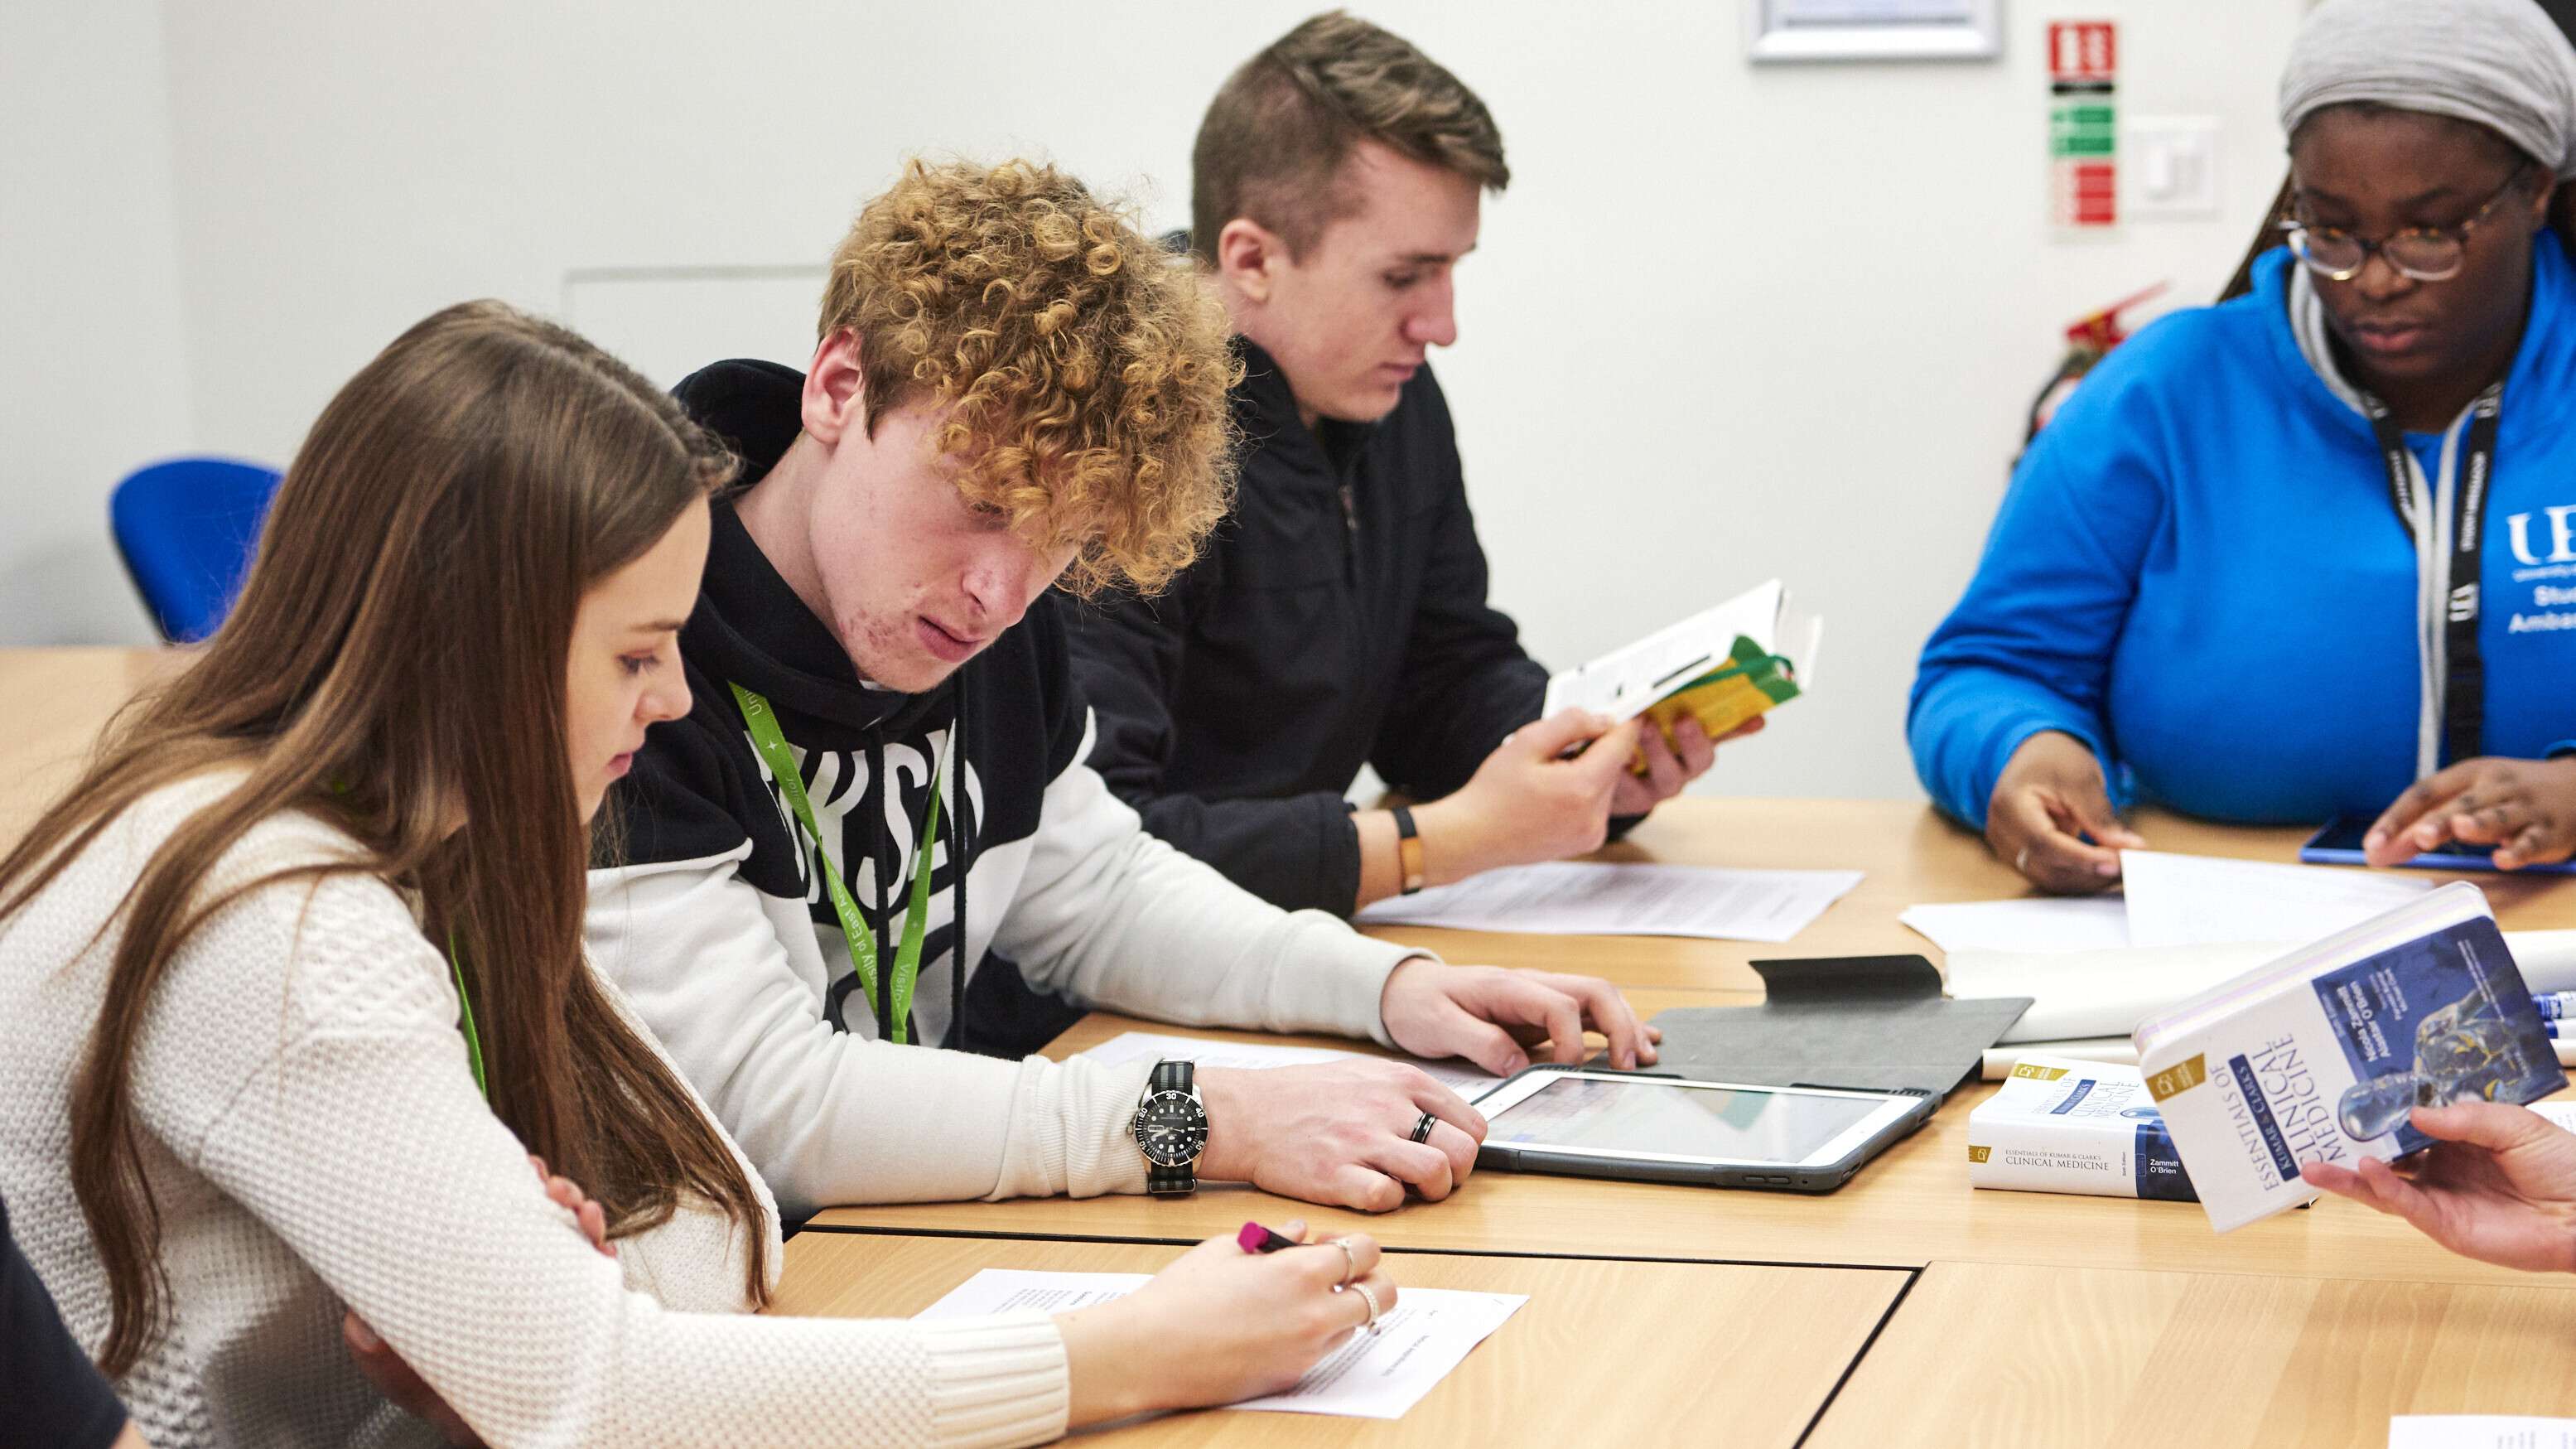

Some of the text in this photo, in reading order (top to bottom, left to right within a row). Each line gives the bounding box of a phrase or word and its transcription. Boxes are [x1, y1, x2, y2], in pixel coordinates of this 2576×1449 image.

[844, 908, 863, 939] East
[855, 939, 867, 952] of
[2252, 1041, 2324, 1166] CLINICAL
[2272, 1033, 2347, 1162] MEDICINE
[1139, 1107, 1148, 1118] 20
[1195, 1107, 1204, 1118] 40
[2209, 1065, 2279, 1191] ESSENTIALS OF
[2265, 1125, 2292, 1171] KUMAR
[2005, 1157, 2110, 1171] CLINICAL MEDICINE
[2149, 1158, 2179, 1168] Zammitt
[2149, 1166, 2177, 1175] O'Brien
